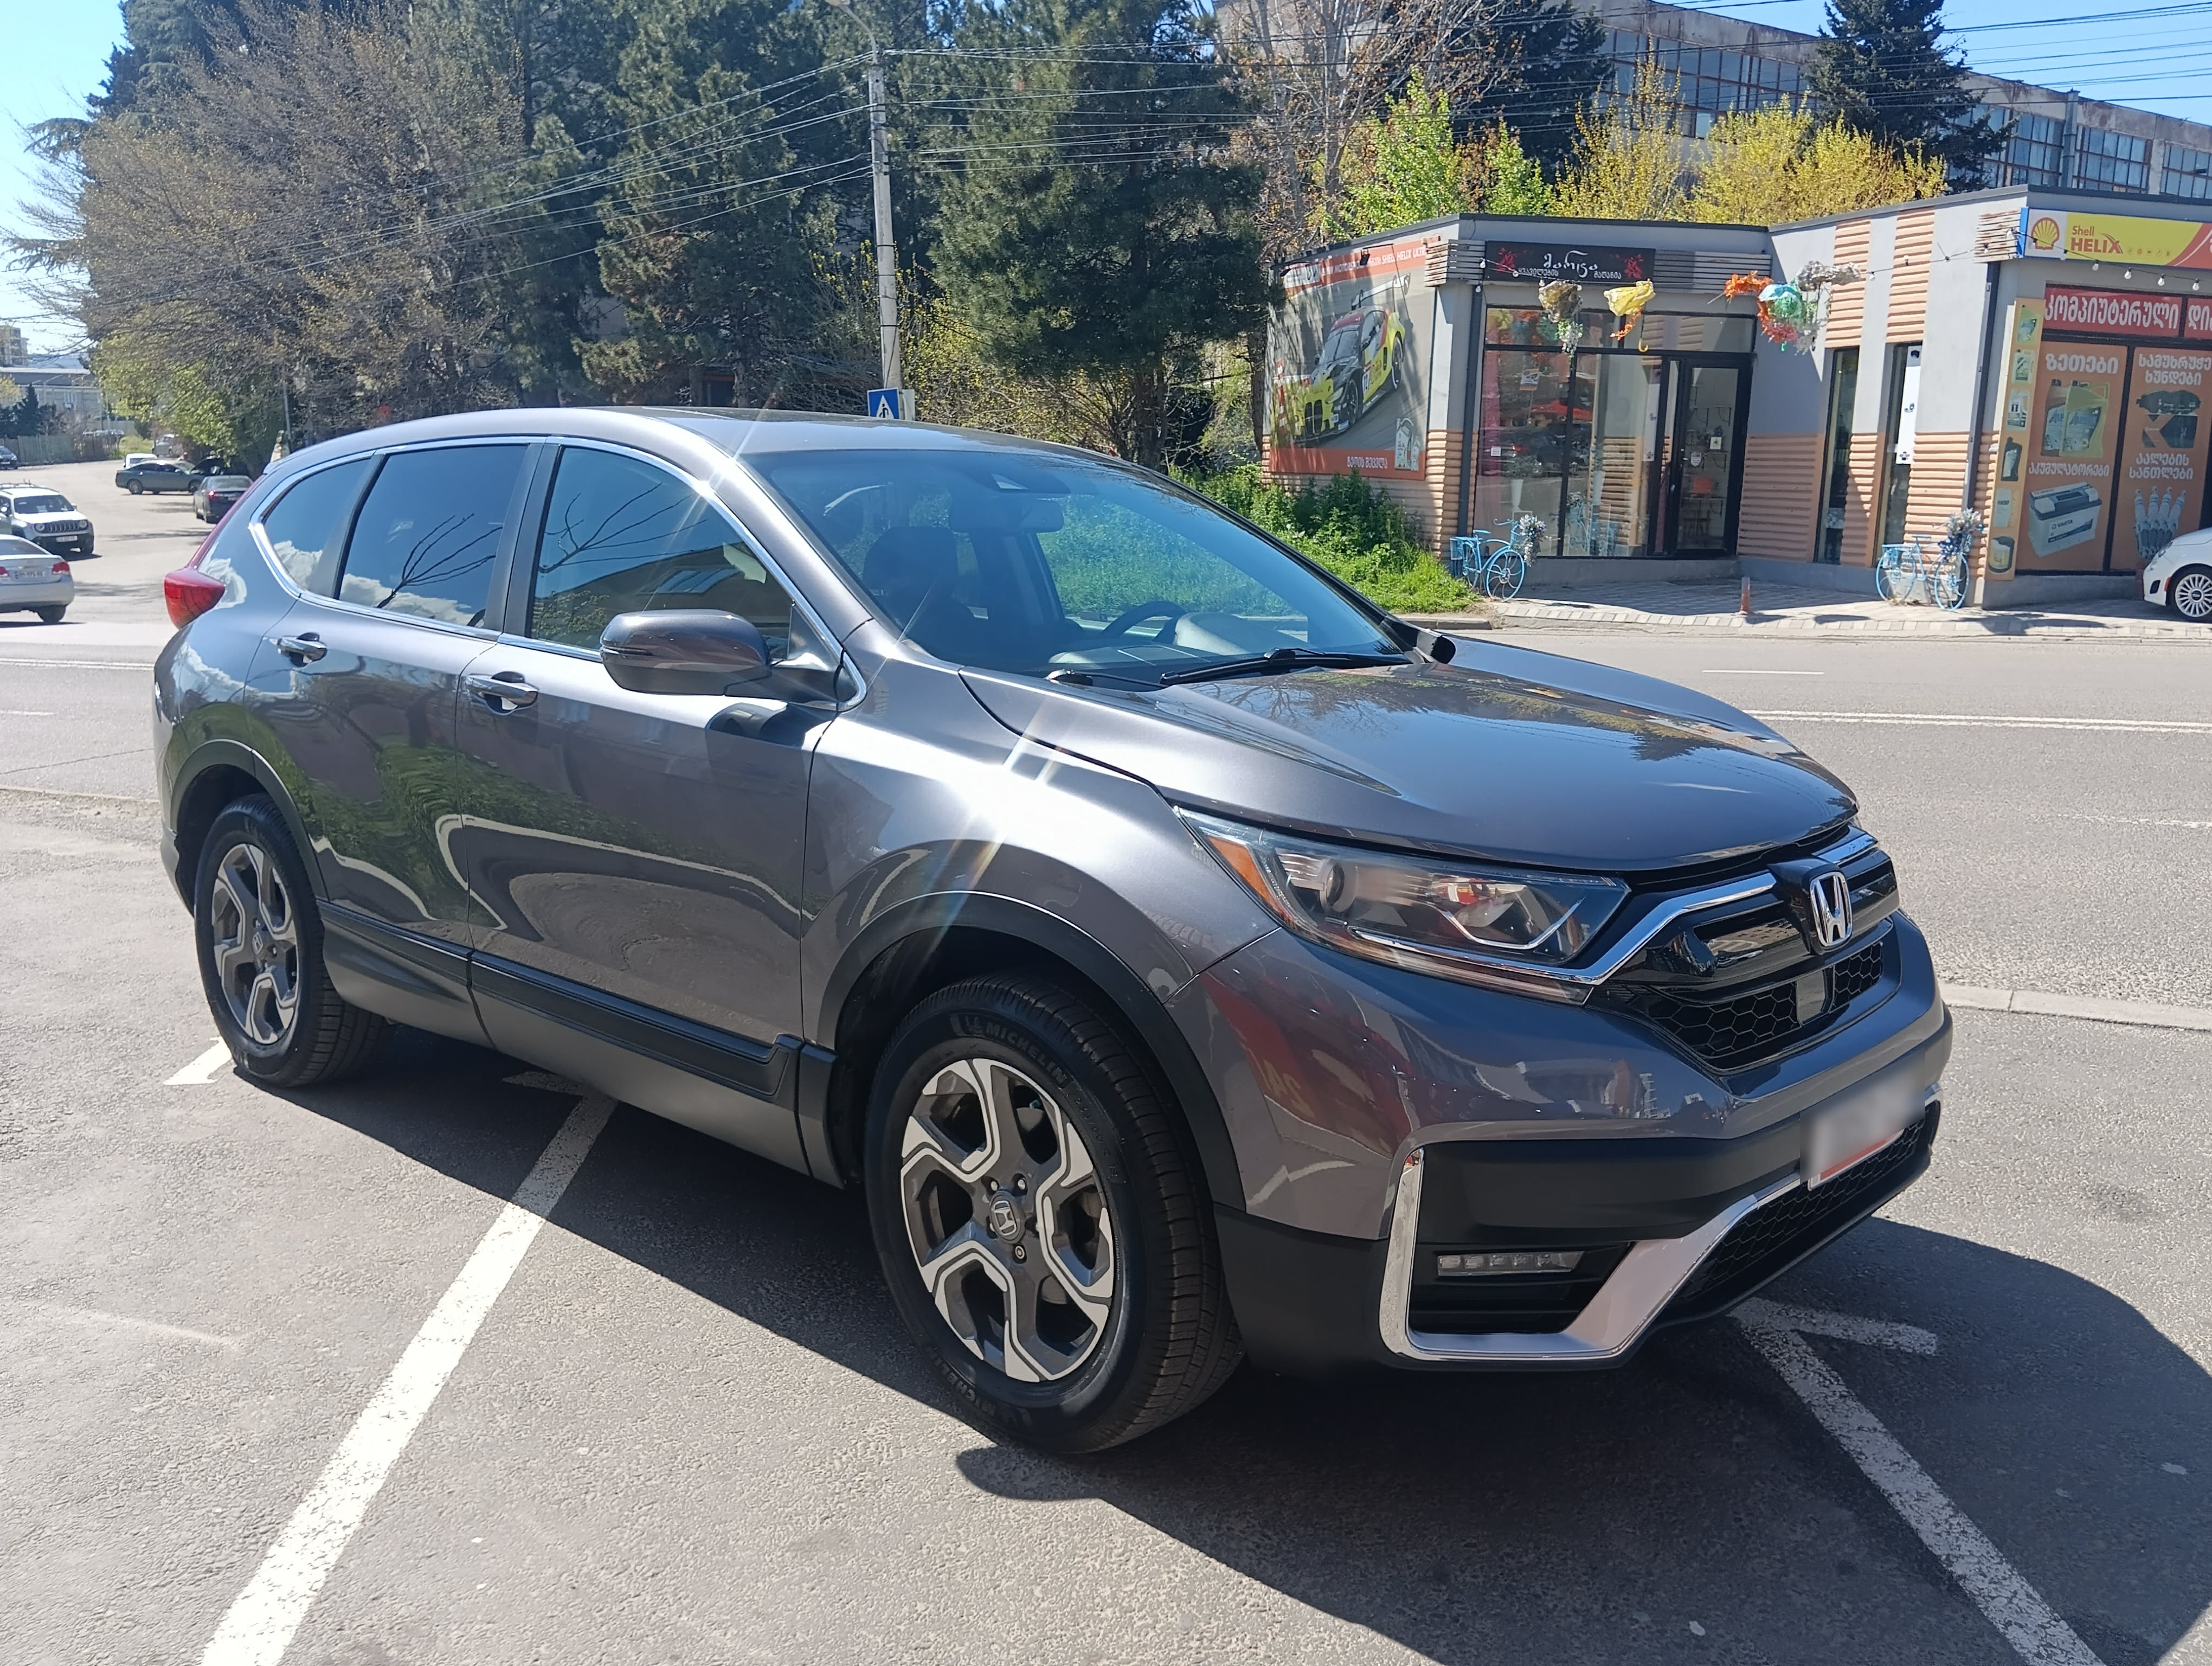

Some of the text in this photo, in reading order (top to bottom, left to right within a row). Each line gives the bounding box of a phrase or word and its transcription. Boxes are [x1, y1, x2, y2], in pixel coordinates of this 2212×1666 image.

[2072, 226, 2094, 236] Shell
[2071, 236, 2122, 254] HELIX
[1397, 249, 1412, 261] HELIX
[2044, 294, 2178, 329] კომპიუტერული
[2046, 354, 2118, 374] ზეთები
[2145, 370, 2202, 386] ხუნდები
[2136, 452, 2189, 465] აალების
[2029, 462, 2110, 477] აკუმულატორები
[2129, 467, 2194, 479] სანთლები
[987, 1022, 1068, 1085] MICHELIN
